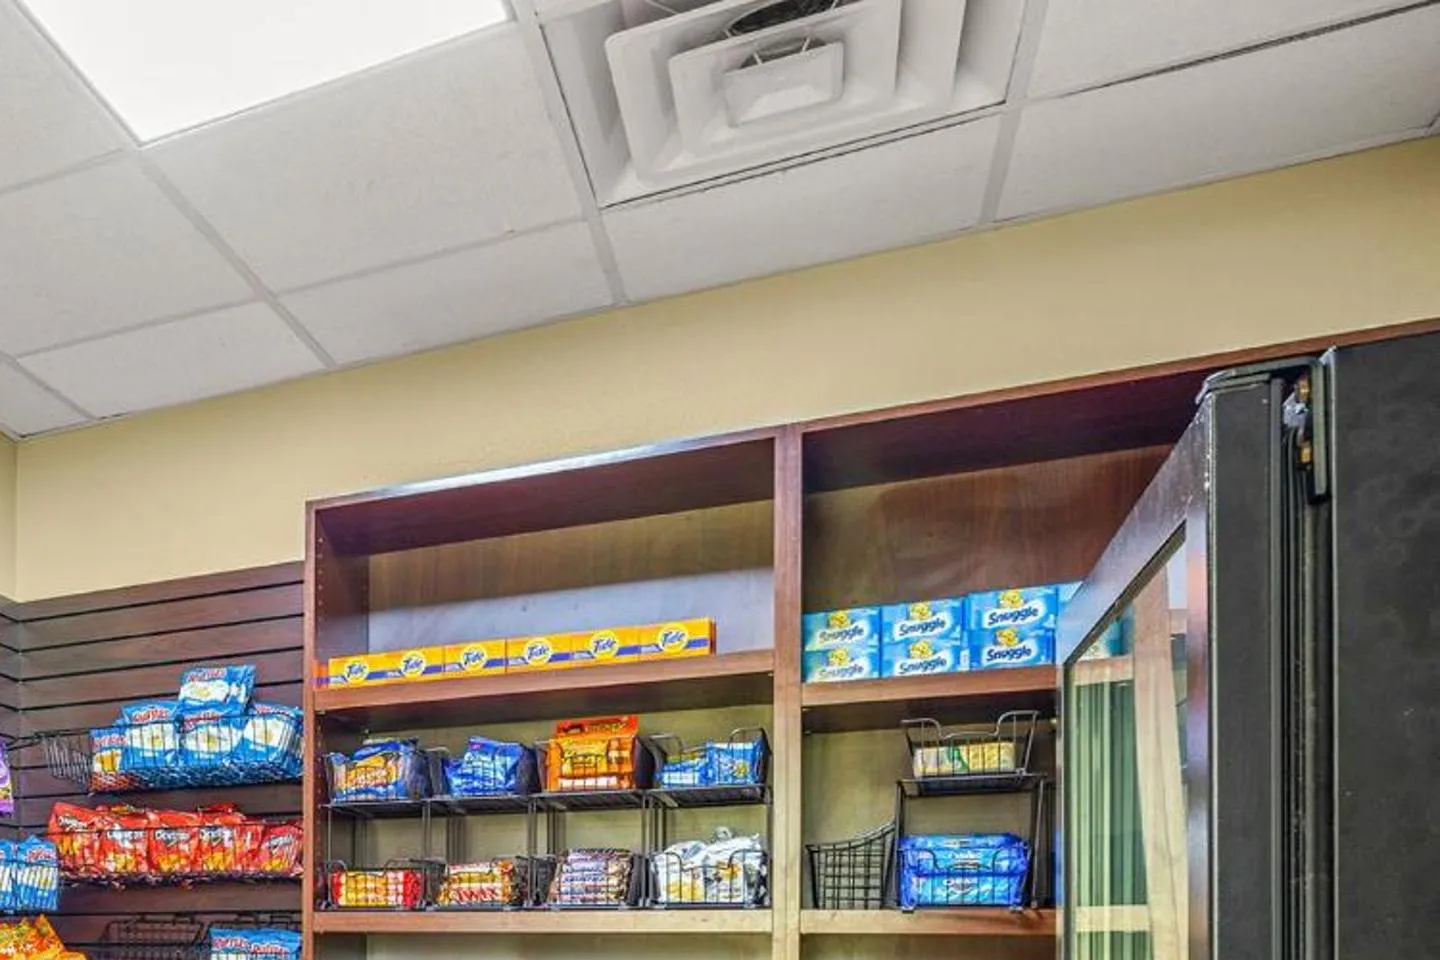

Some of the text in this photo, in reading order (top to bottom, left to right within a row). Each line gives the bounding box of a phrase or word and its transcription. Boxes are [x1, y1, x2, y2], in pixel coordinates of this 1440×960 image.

[987, 605, 1040, 625] Snuggle
[818, 626, 865, 643] Snuggle
[898, 617, 946, 636] Snuggle
[985, 645, 1033, 663] Snuggle
[898, 656, 948, 674] Snuggle
